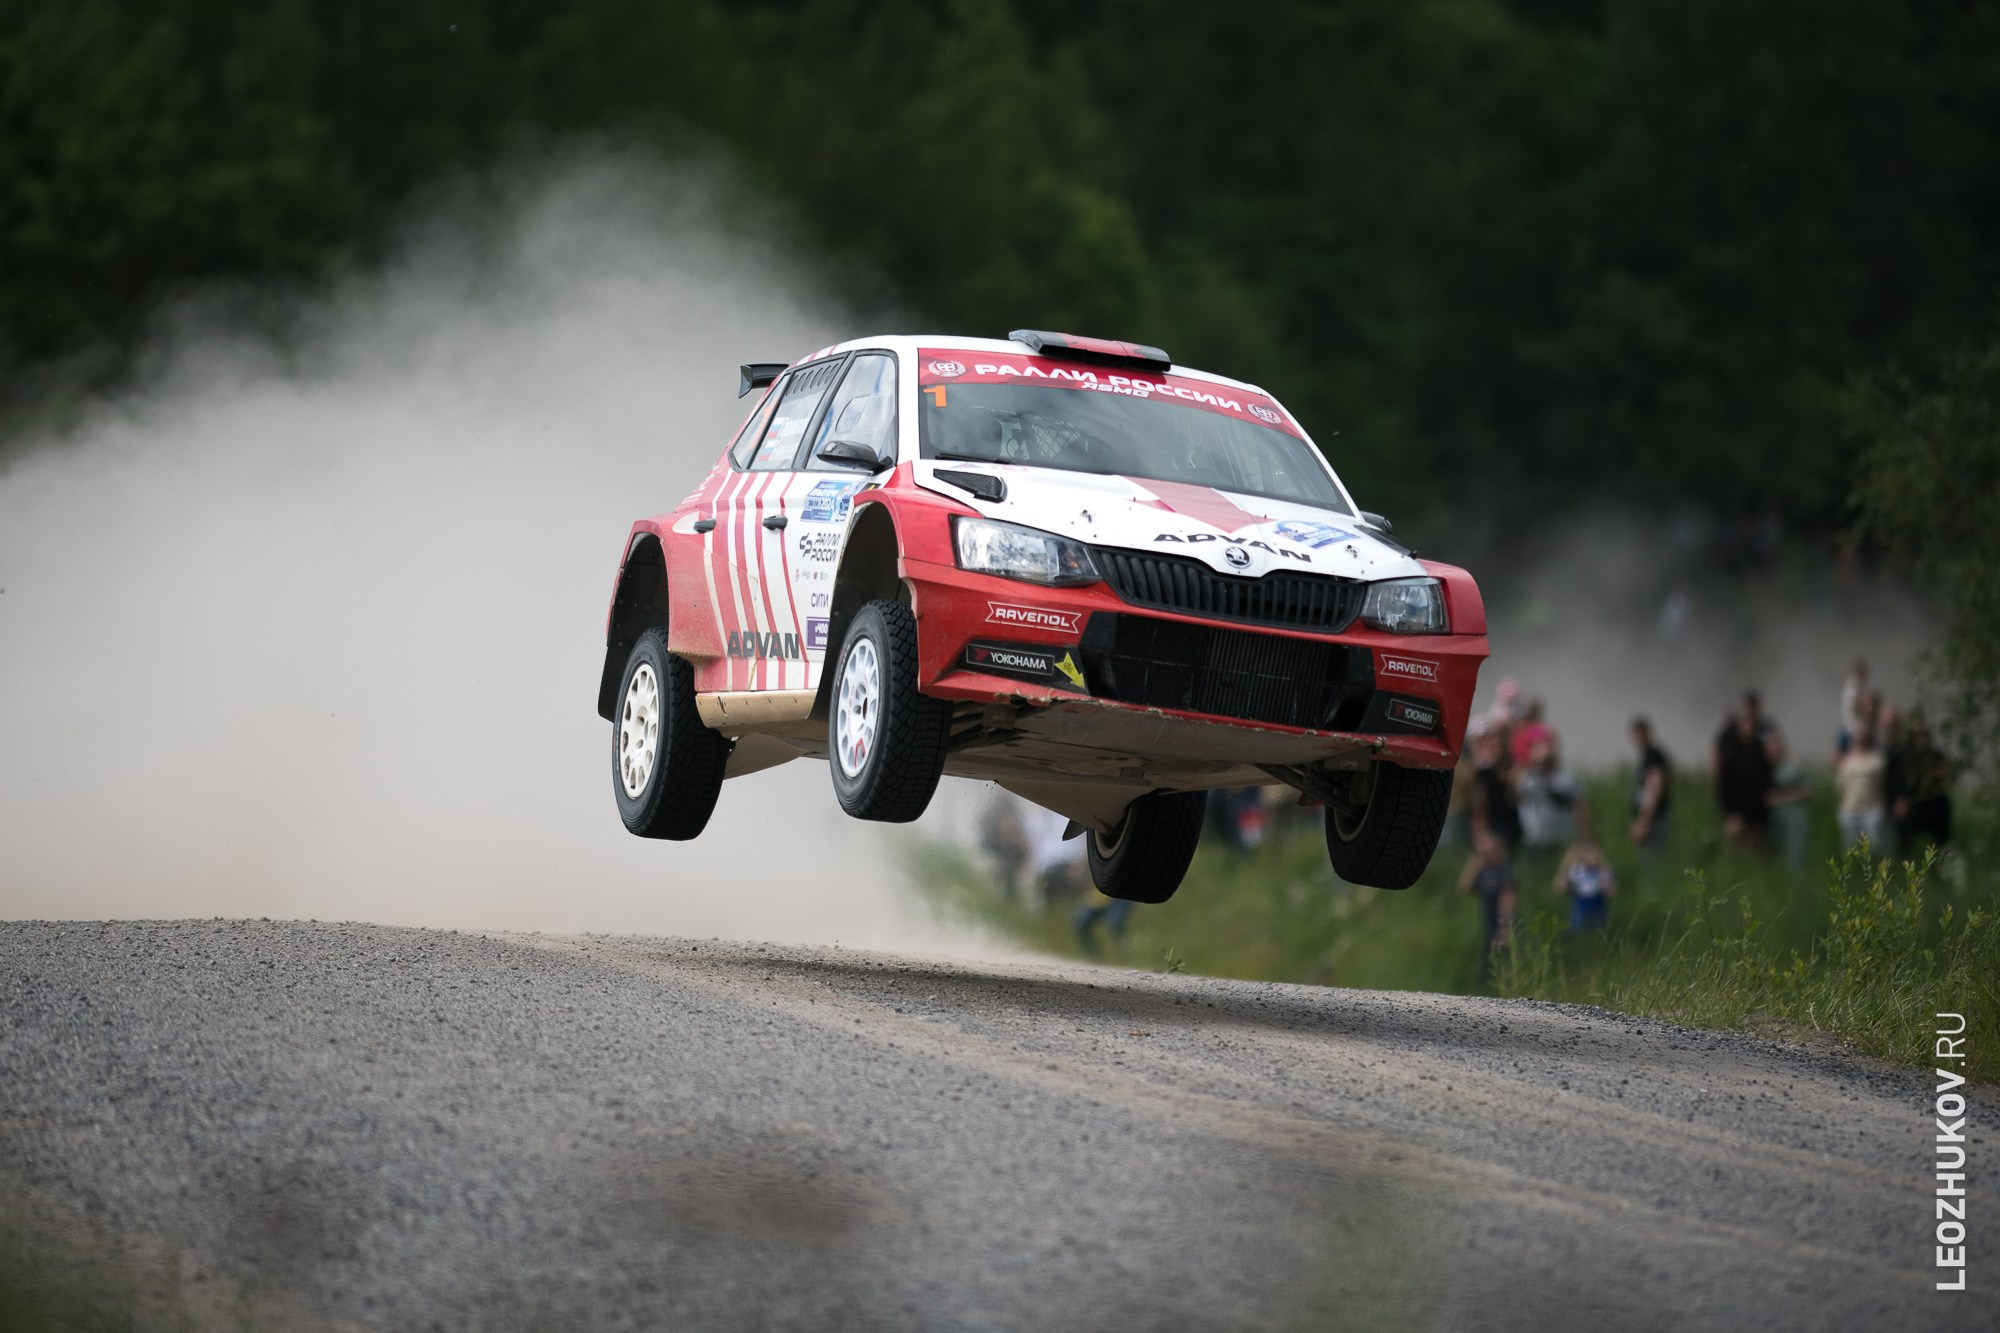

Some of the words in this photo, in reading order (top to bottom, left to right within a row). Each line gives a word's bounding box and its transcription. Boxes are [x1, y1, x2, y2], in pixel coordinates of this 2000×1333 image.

[923, 385, 947, 408] 1
[974, 364, 1098, 382] РАЛЛИ
[1108, 375, 1243, 412] РОССИИ
[814, 532, 841, 546] РАЛЛИ
[1154, 533, 1312, 563] ADVAN
[995, 607, 1070, 627] RAVENOL
[727, 631, 800, 659] ADVAN
[990, 652, 1047, 670] YOKOHAMA
[1388, 660, 1434, 676] RAVENOL
